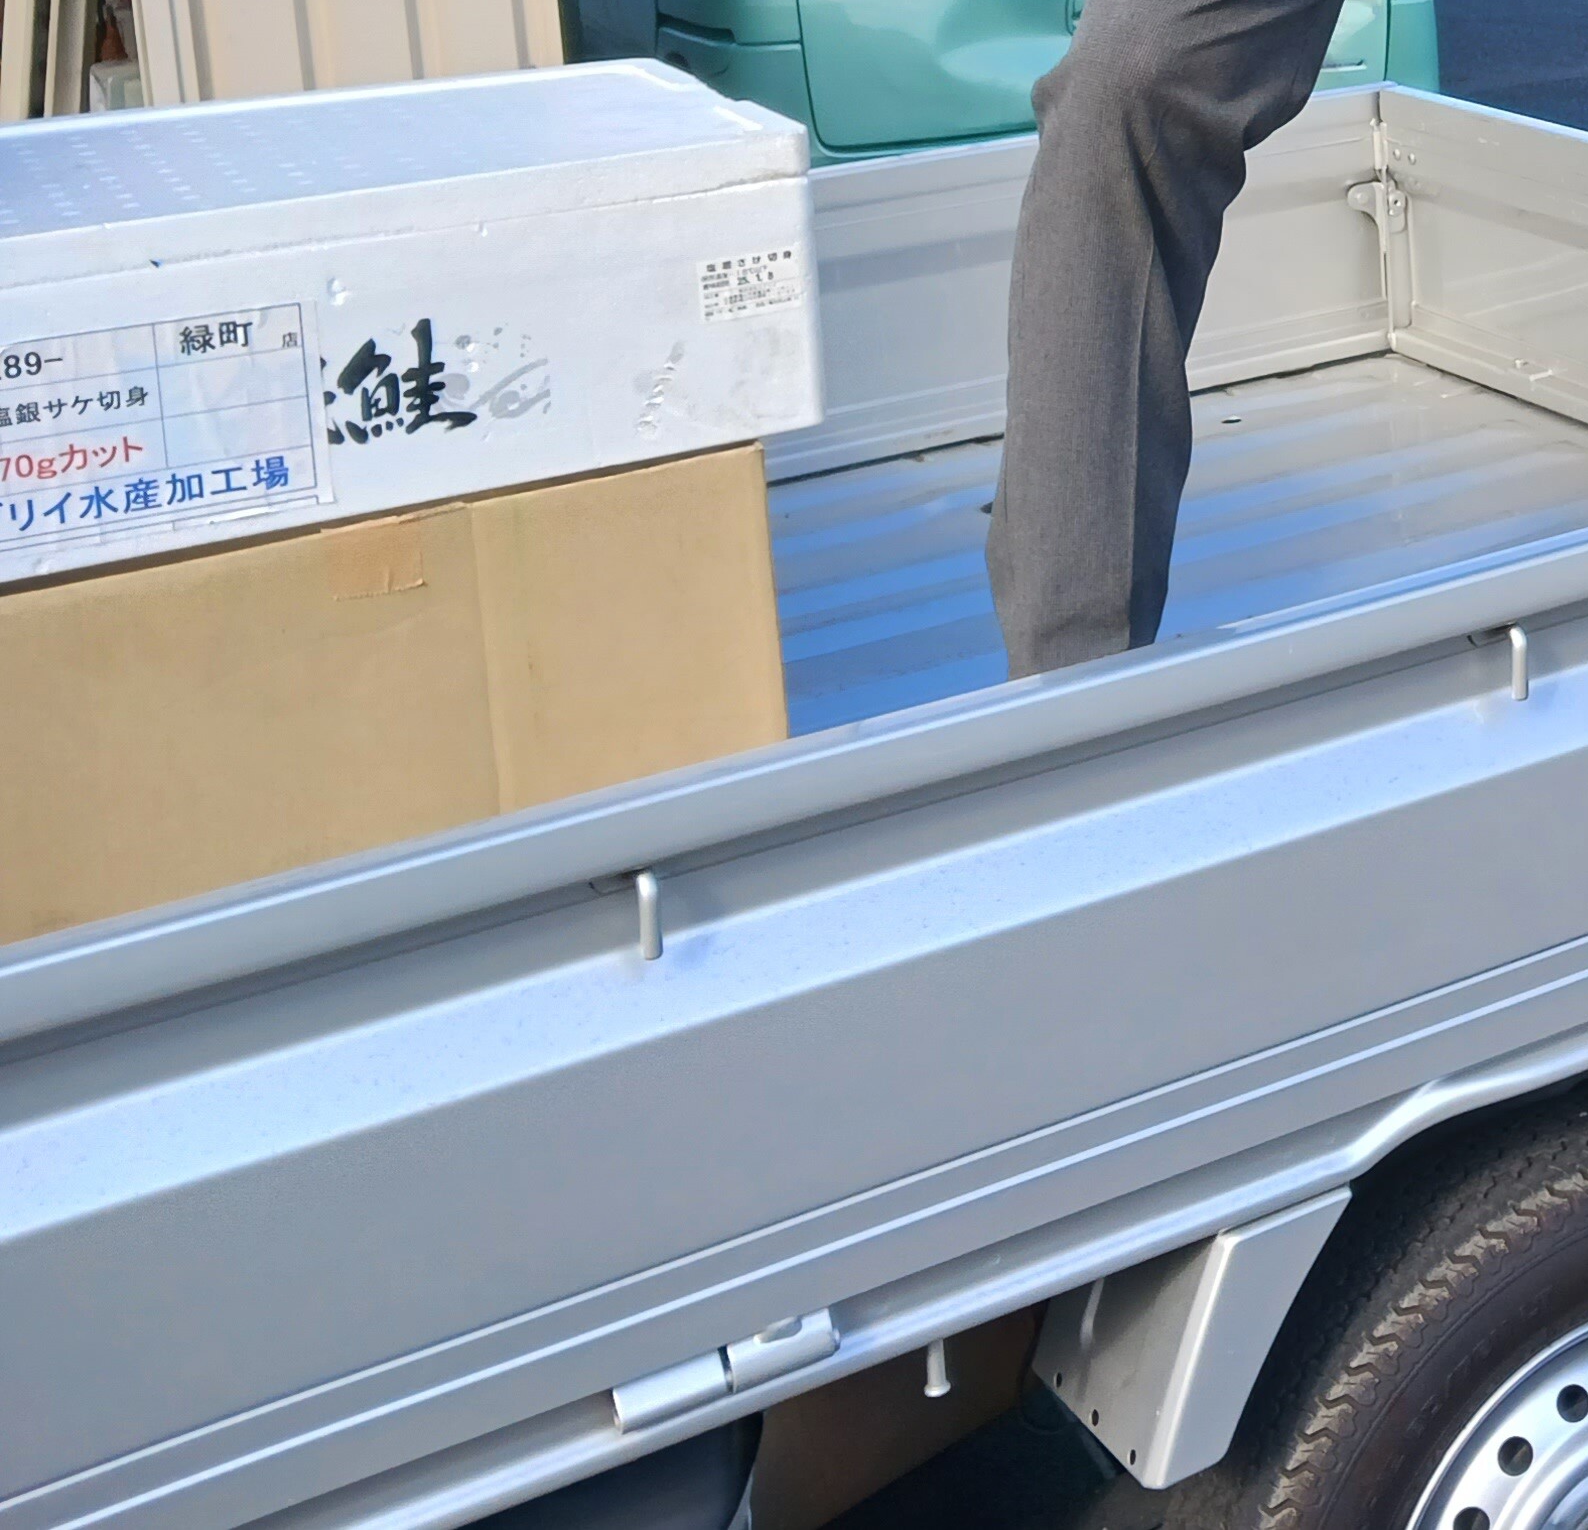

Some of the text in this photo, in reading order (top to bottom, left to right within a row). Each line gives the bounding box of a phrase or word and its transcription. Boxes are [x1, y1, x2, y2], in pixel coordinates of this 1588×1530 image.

[180, 321, 299, 355] 緑町 店
[0, 351, 63, 381] 89-
[320, 318, 478, 444] 鮭
[0, 436, 144, 482] 70gカット
[0, 455, 290, 532] リイ水産加工場
